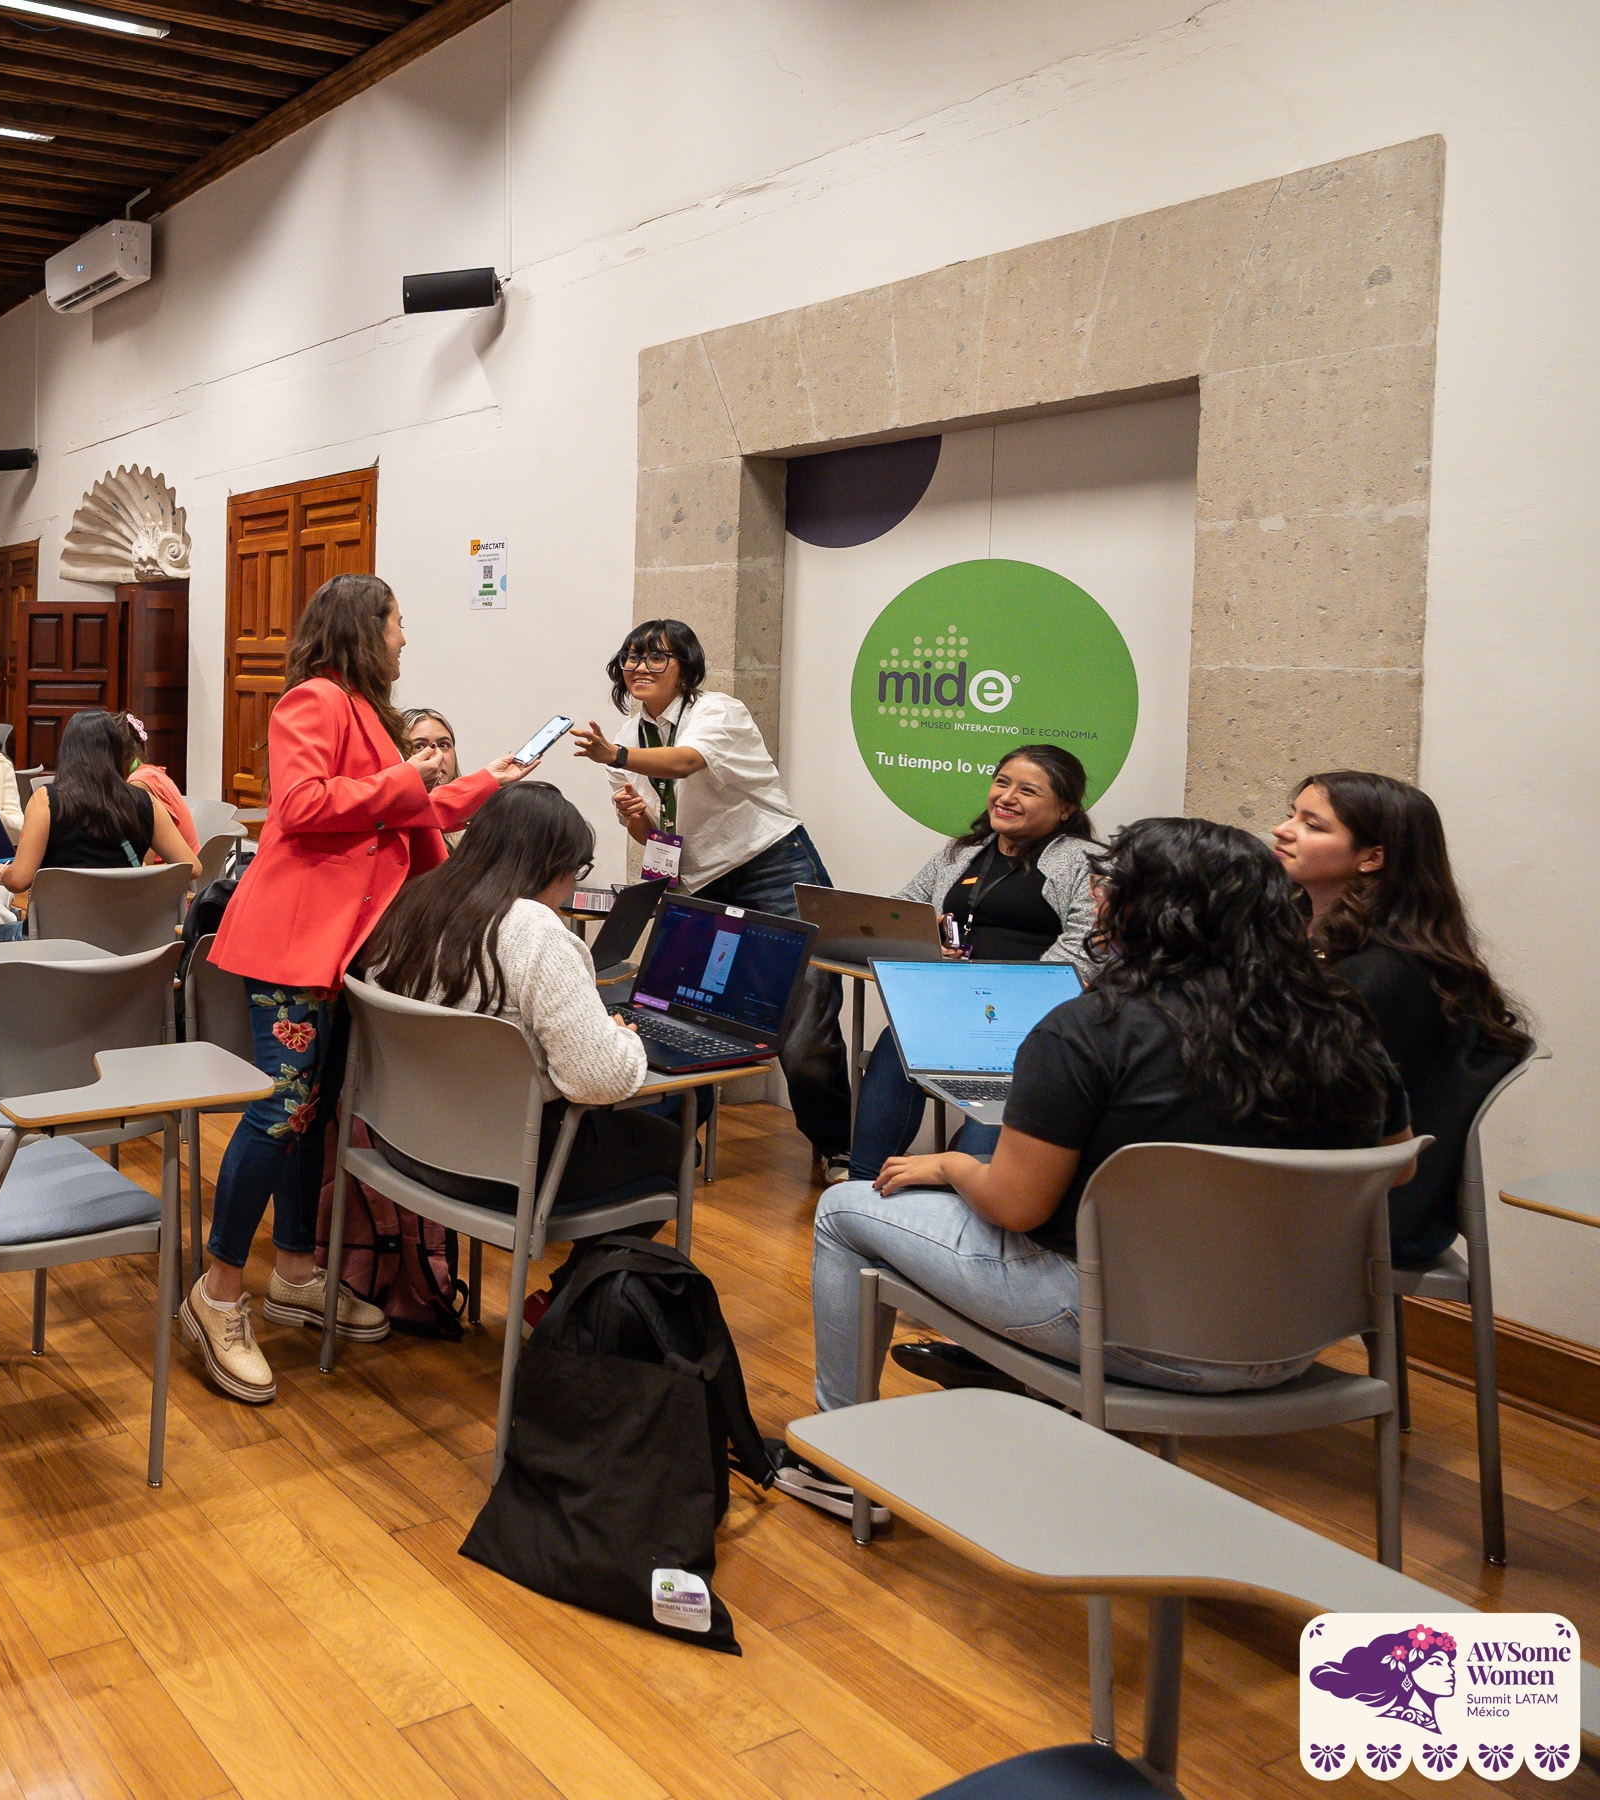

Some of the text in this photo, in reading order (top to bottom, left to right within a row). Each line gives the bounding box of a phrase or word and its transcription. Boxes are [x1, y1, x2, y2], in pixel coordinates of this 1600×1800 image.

[472, 542, 505, 551] CONÉCTATE
[920, 720, 1099, 740] MUSEO INTERACTIVO DE ECONOMÍA
[875, 751, 894, 767] Tu
[897, 753, 953, 774] tiempo
[957, 758, 973, 773] lo
[656, 1602, 707, 1614] WOMEN SUMMIT
